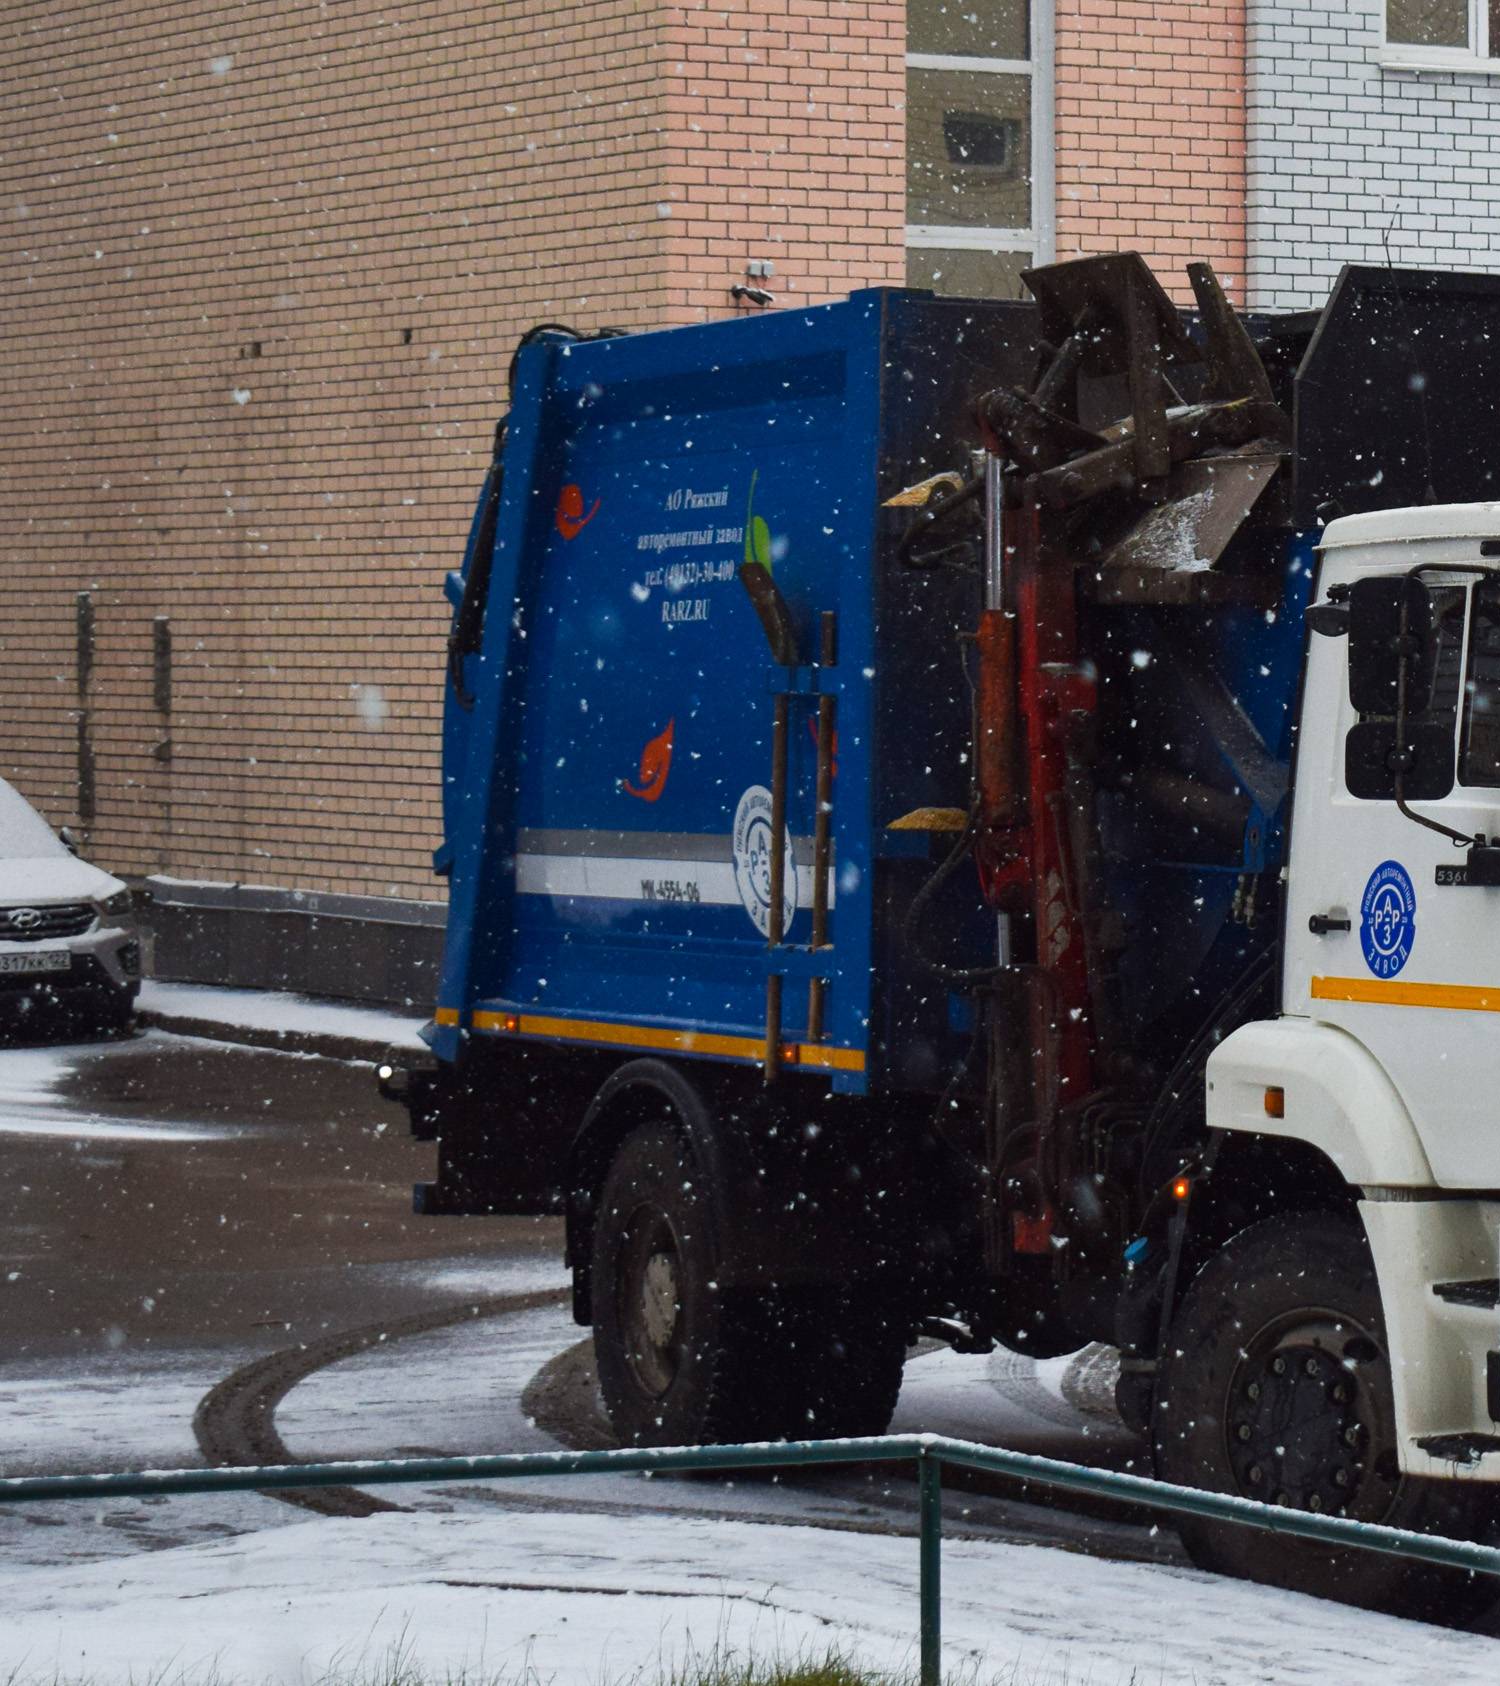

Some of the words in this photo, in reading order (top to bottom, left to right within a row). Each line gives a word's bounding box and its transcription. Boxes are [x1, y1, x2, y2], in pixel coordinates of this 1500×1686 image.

[664, 489, 682, 511] АО
[684, 485, 729, 509] Ряжский
[637, 525, 714, 554] авторемонтный
[715, 527, 743, 544] завод
[662, 599, 711, 622] RARZ.RU
[0, 956, 45, 970] 317КК
[1368, 945, 1408, 974] ЗАВОД
